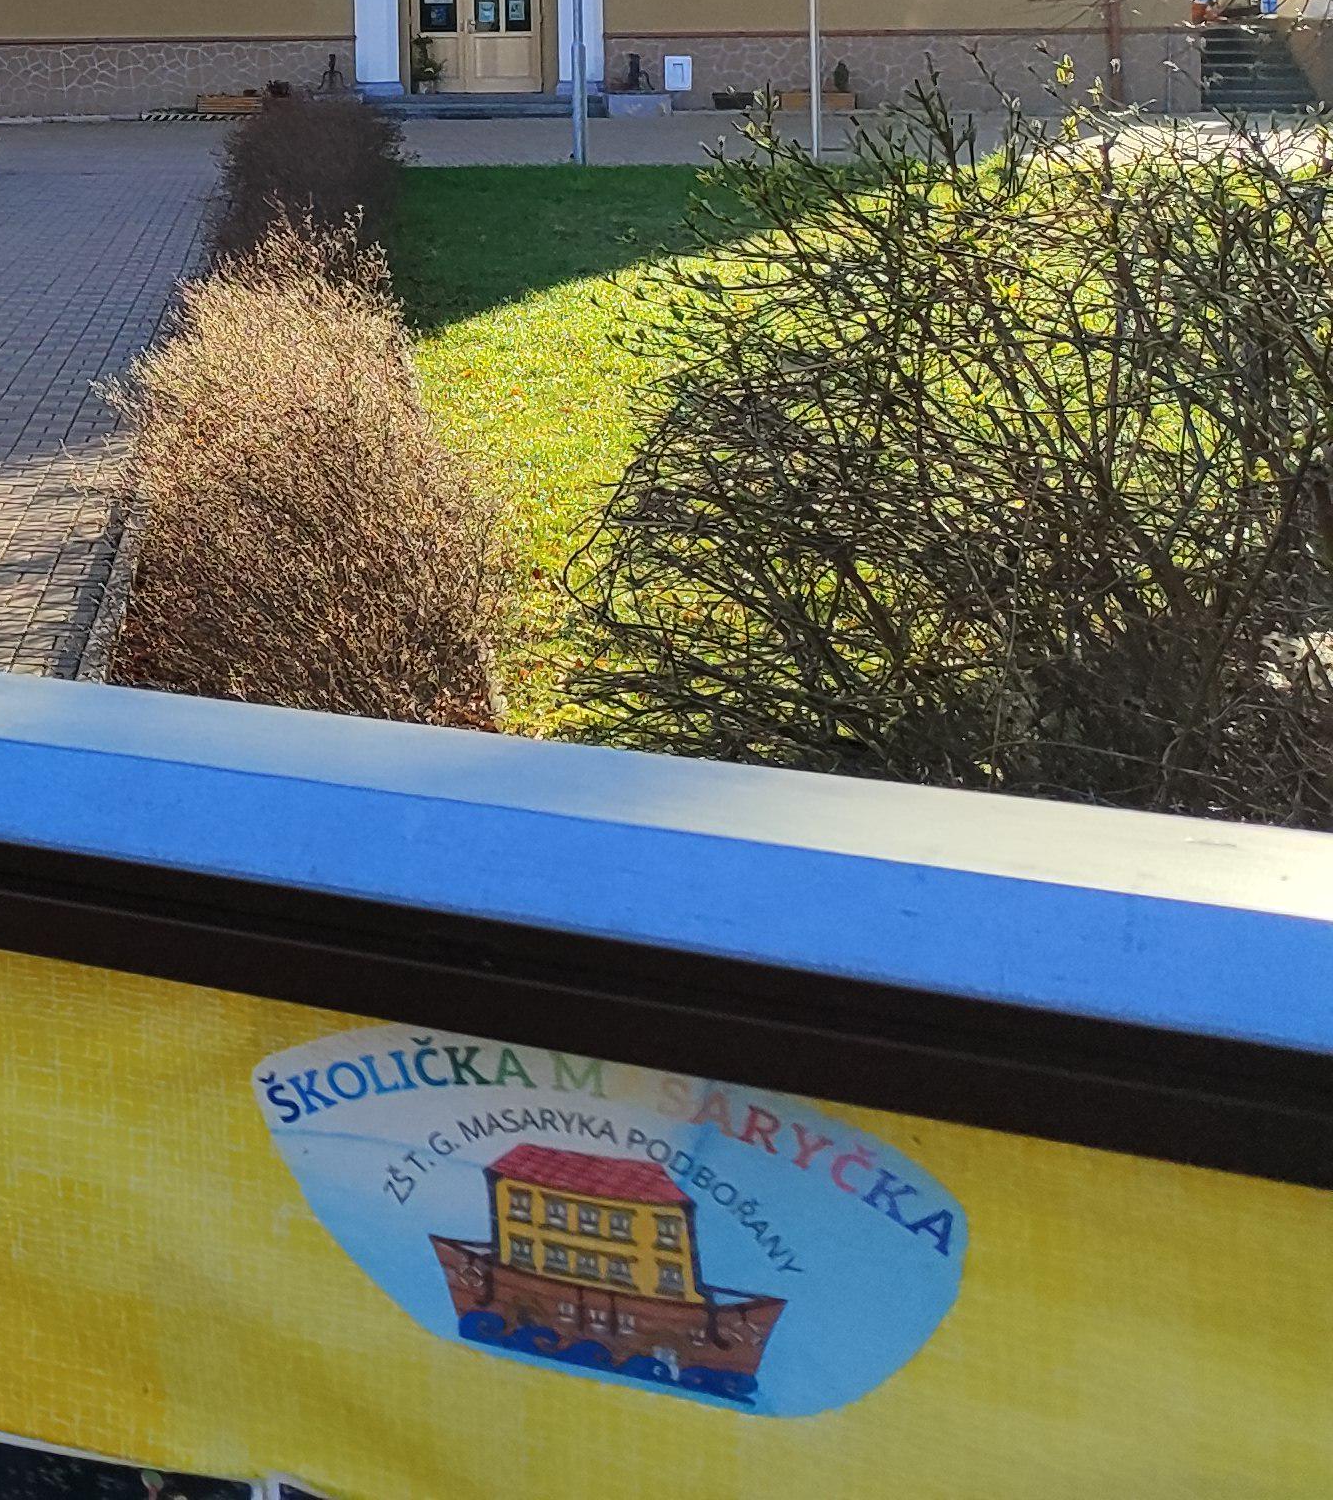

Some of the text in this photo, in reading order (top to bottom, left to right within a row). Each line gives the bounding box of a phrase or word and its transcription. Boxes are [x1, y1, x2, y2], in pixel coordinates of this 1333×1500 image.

[258, 1036, 954, 1257] ŠKOLIČKA MSARYČKA
[383, 1107, 805, 1275] ZŠ T. G. MASARYKA PODBOŘANY
